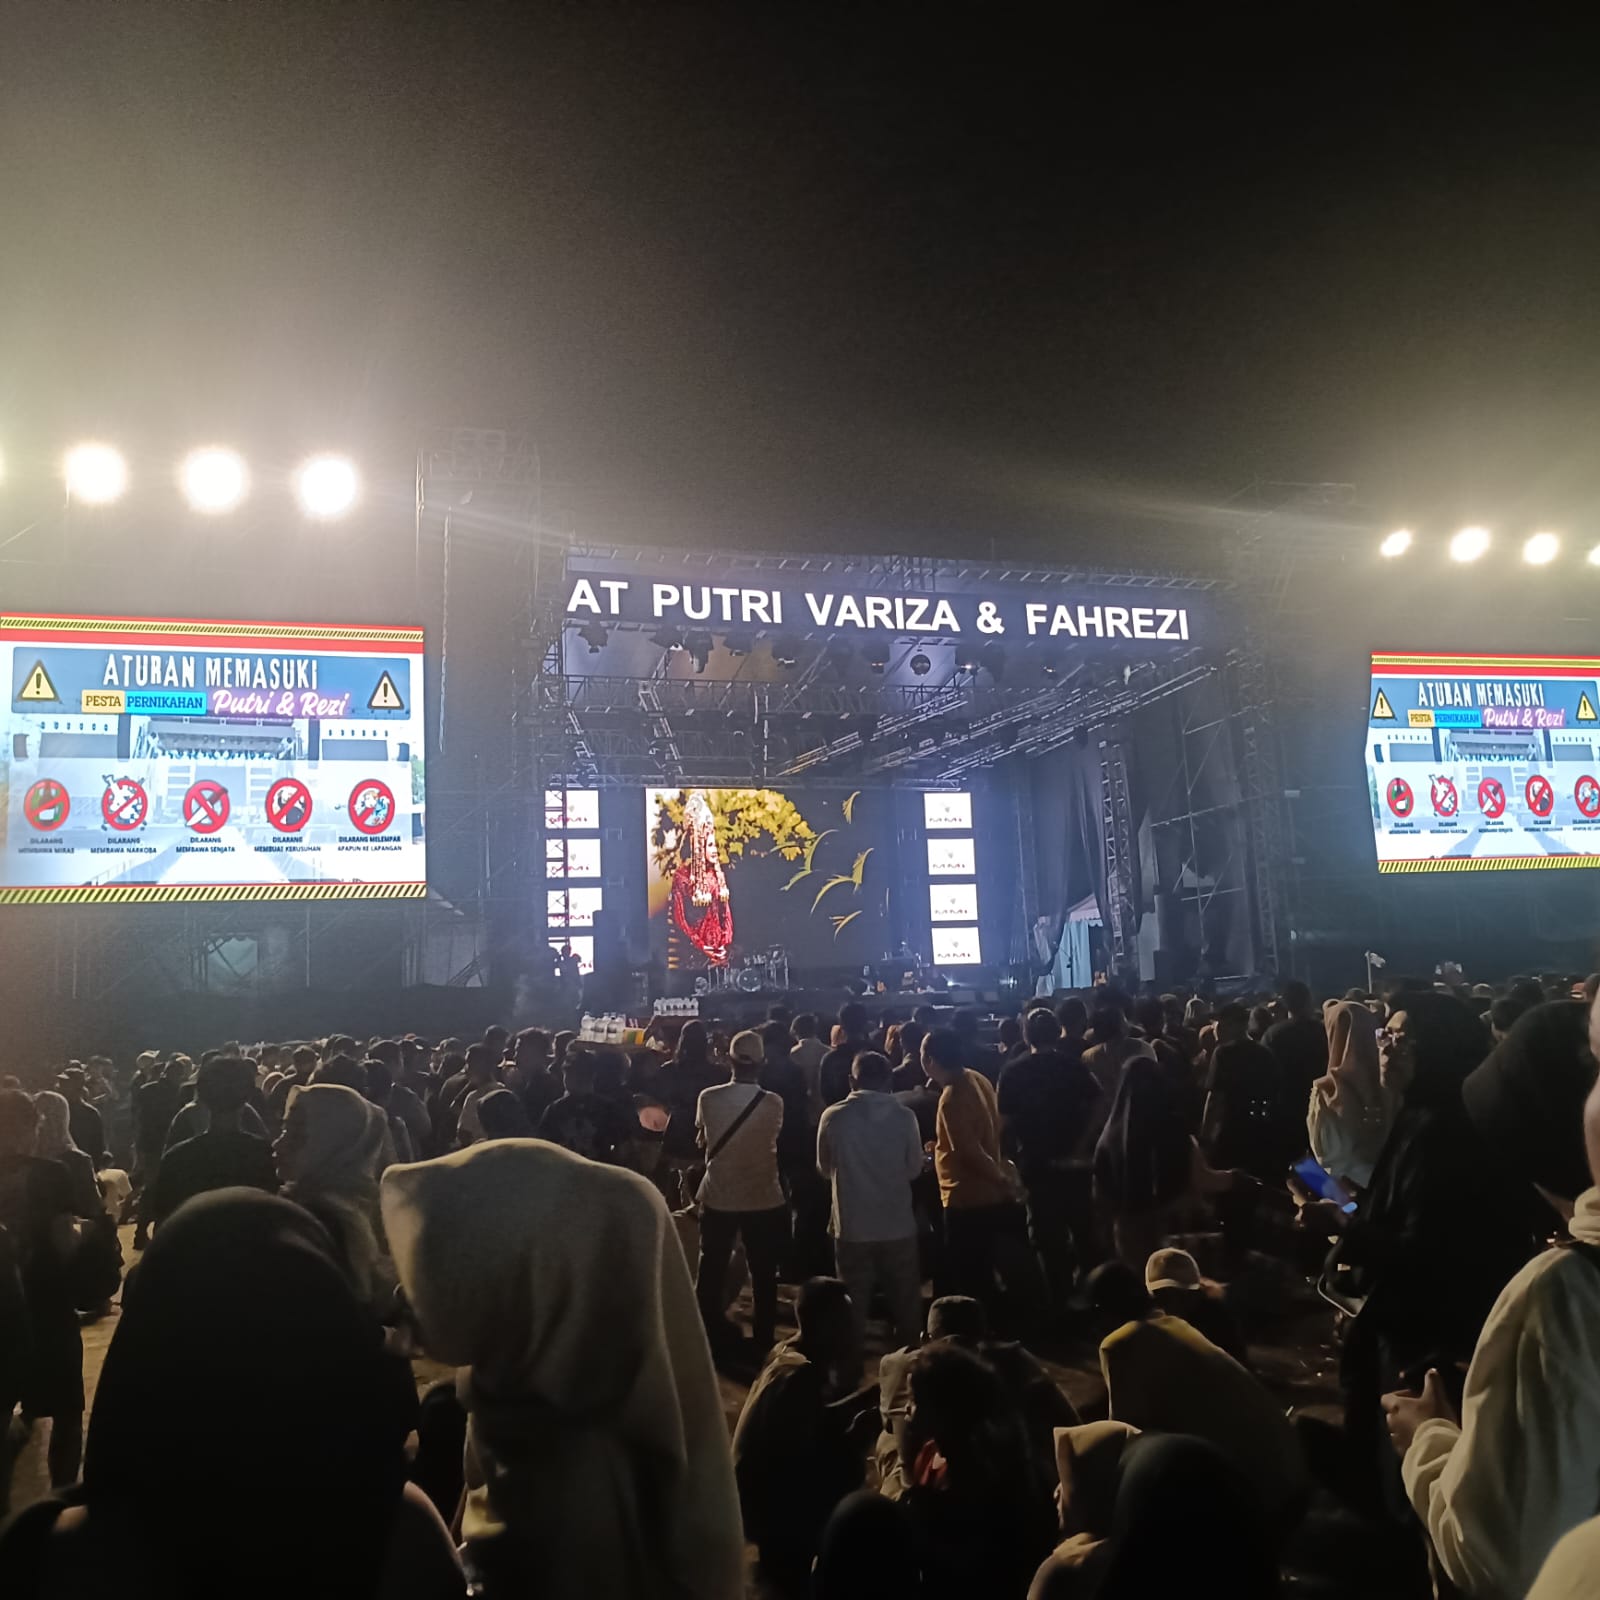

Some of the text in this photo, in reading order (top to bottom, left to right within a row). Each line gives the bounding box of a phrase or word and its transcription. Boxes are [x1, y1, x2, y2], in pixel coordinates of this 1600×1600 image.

[567, 579, 1189, 640] AT PUTRI VARIZA & FAHREZI
[103, 653, 318, 690] ATURAN MEMASUKI
[85, 690, 350, 717] PESTA PERNIKAHAN Putri & Rezi
[1418, 682, 1545, 707] ATURAN MEMASUKI
[1483, 708, 1518, 727] Putri
[1522, 709, 1533, 727] &
[1535, 708, 1565, 727] Rezi
